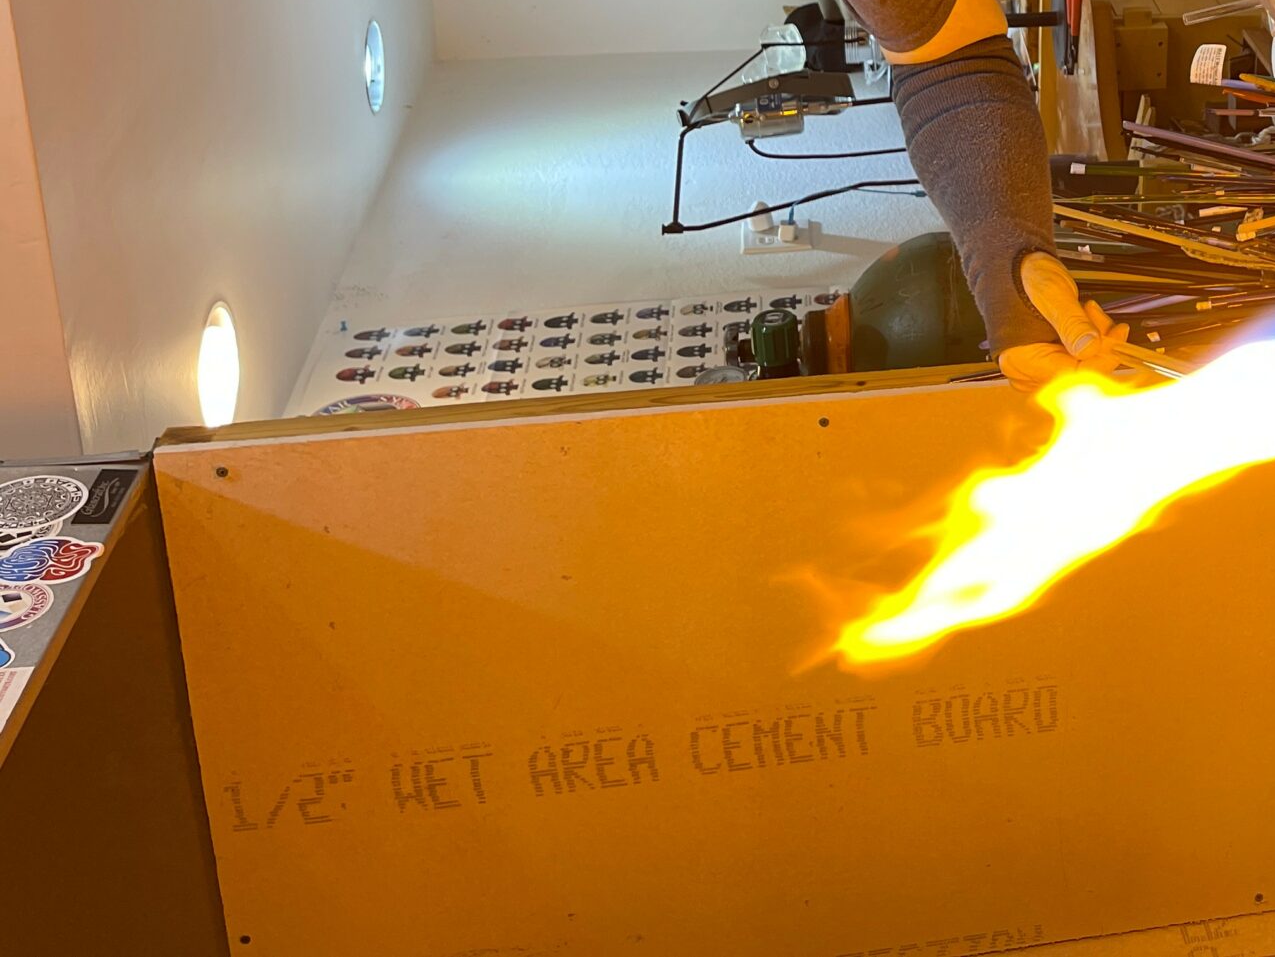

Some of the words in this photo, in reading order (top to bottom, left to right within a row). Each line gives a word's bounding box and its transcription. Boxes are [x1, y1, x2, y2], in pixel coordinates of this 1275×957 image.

[390, 752, 493, 814] WET
[528, 734, 660, 797] AREA
[690, 705, 878, 775] CEMENT
[912, 684, 1060, 747] BOARD
